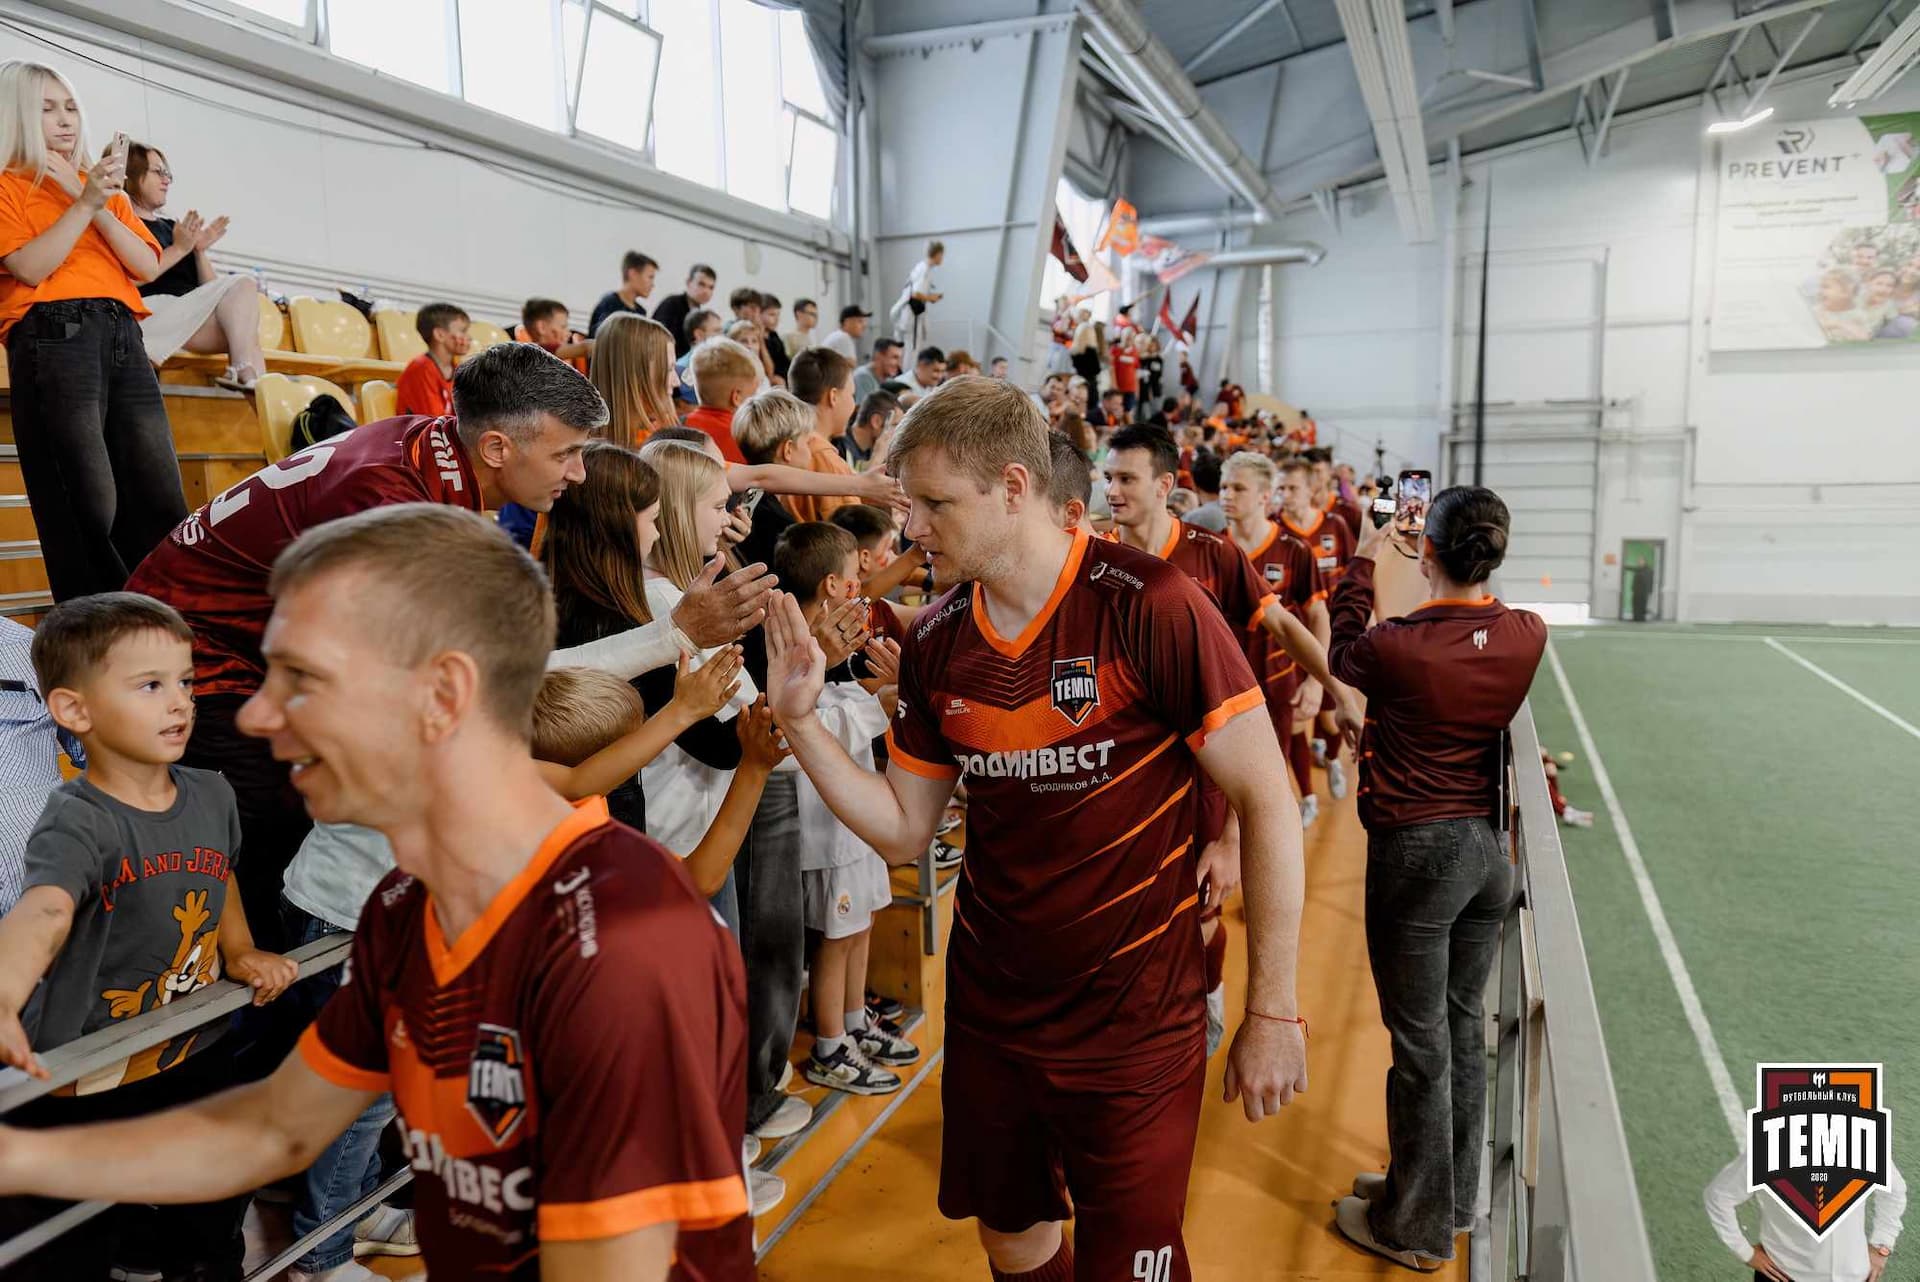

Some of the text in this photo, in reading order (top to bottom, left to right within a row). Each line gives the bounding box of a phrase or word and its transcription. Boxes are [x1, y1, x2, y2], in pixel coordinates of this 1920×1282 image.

[1728, 156, 1845, 179] PREVENT
[1055, 677, 1095, 702] ТЕМП
[143, 851, 182, 879] AND
